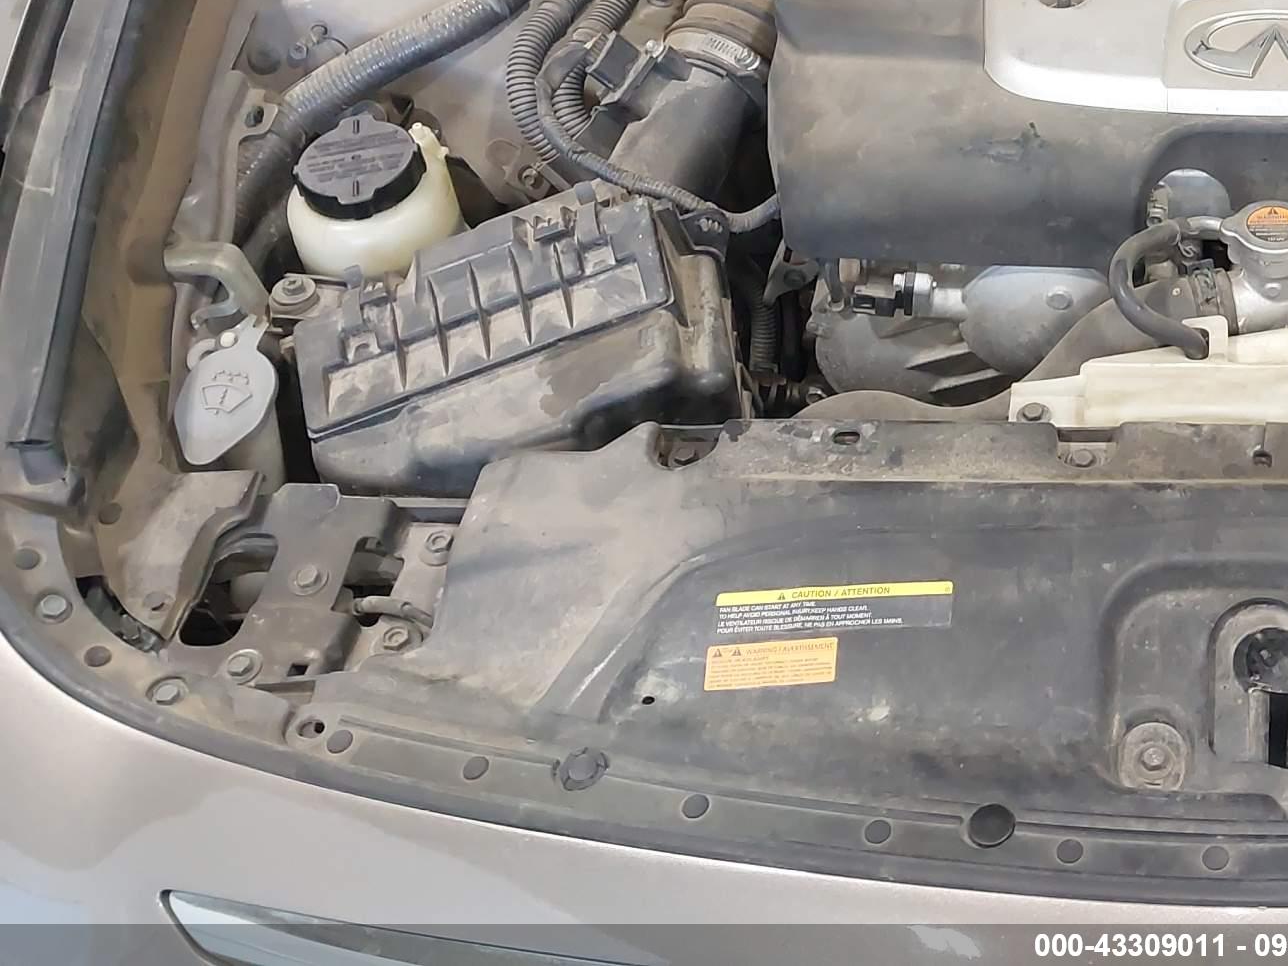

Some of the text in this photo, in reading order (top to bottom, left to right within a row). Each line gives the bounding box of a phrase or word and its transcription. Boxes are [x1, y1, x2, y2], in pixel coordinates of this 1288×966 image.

[791, 590, 831, 599] CAUTION
[840, 587, 890, 596] ATTENTION
[761, 609, 791, 617] PERSONAL
